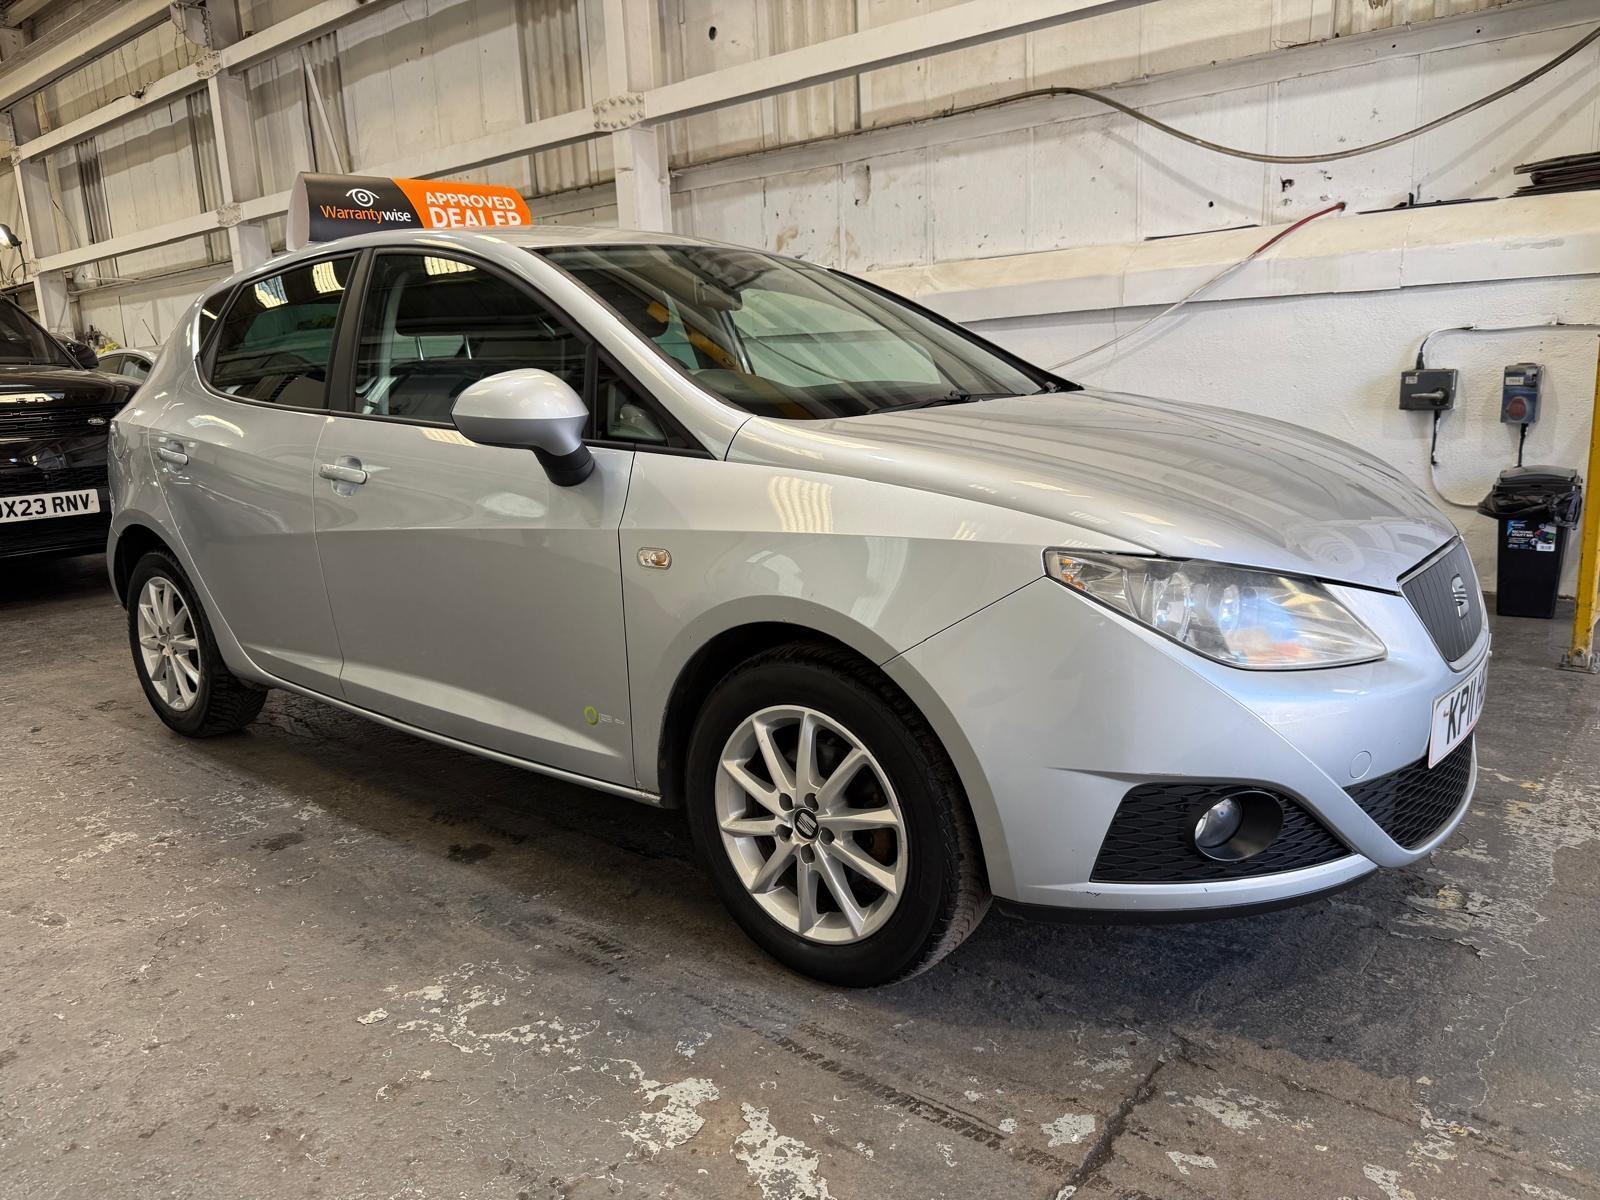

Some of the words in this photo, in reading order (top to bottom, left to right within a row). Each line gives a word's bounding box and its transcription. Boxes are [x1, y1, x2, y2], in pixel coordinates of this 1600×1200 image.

[426, 192, 516, 209] APPROVED
[320, 205, 412, 224] Warrantywise
[0, 498, 46, 518] X23
[52, 493, 90, 514] RNV
